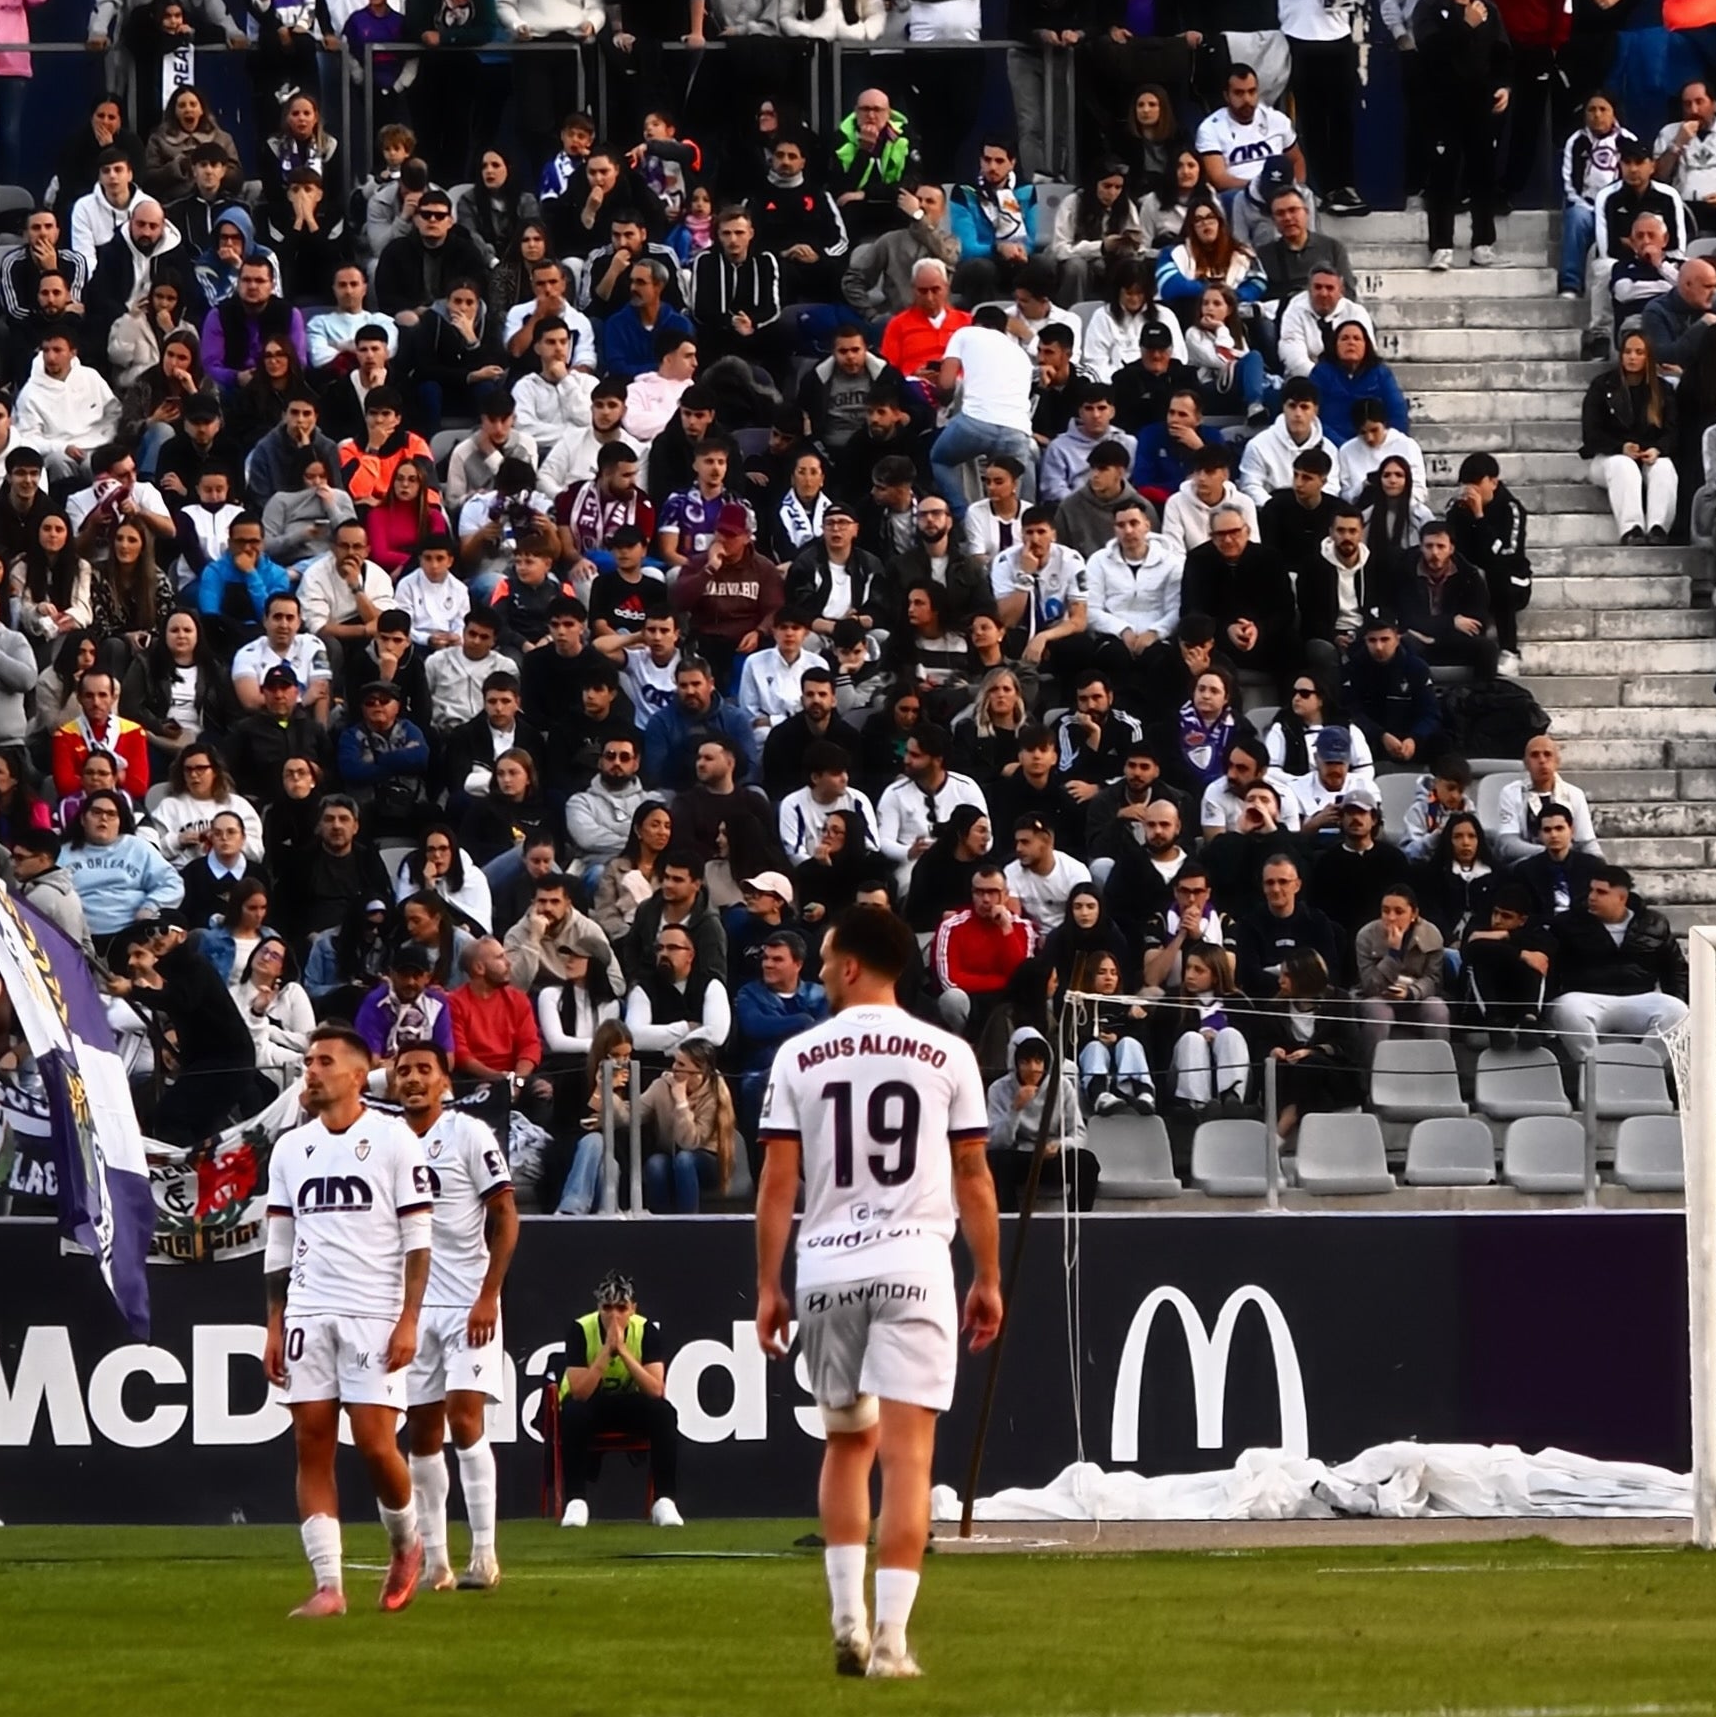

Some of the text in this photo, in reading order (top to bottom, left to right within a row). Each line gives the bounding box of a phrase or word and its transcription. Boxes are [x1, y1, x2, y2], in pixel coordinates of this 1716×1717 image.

[86, 857, 141, 880] ORLEANS
[796, 1032, 949, 1072] AGUS ALONSO
[821, 1080, 921, 1188] 19
[838, 1281, 928, 1307] HYUNDAI
